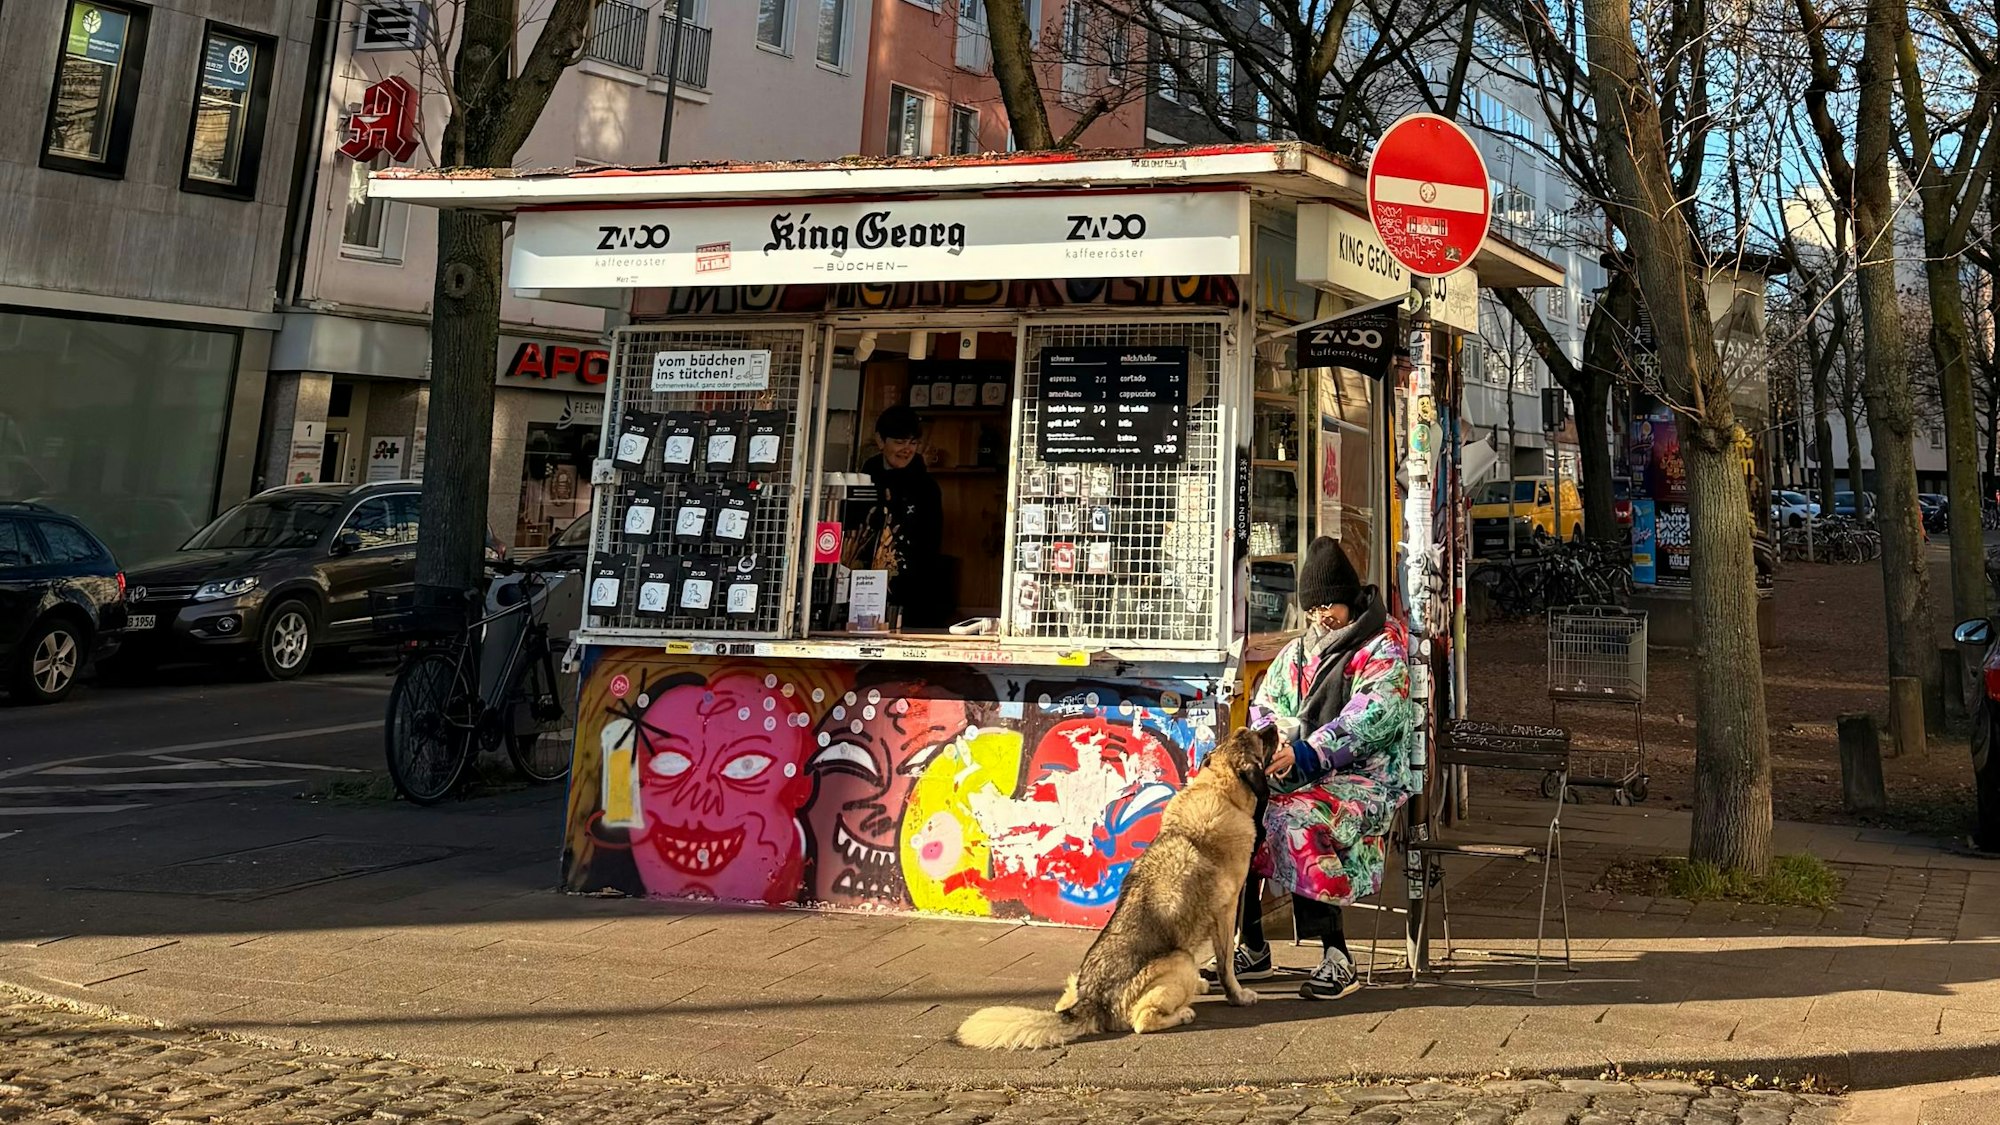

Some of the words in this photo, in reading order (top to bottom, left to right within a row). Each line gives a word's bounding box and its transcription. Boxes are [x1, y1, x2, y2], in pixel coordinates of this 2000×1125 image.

[763, 212, 849, 258] King
[855, 211, 965, 256] Georg
[1065, 248, 1144, 259] kaffeeröster
[1339, 231, 1364, 268] KING
[1367, 244, 1400, 282] GEORG
[659, 358, 686, 366] vom
[690, 354, 745, 366] büdchen
[657, 369, 674, 380] ins
[679, 368, 734, 380] tütchen!
[1120, 374, 1146, 382] cortado
[1120, 390, 1156, 398] cappuccino
[135, 616, 155, 629] 1956
